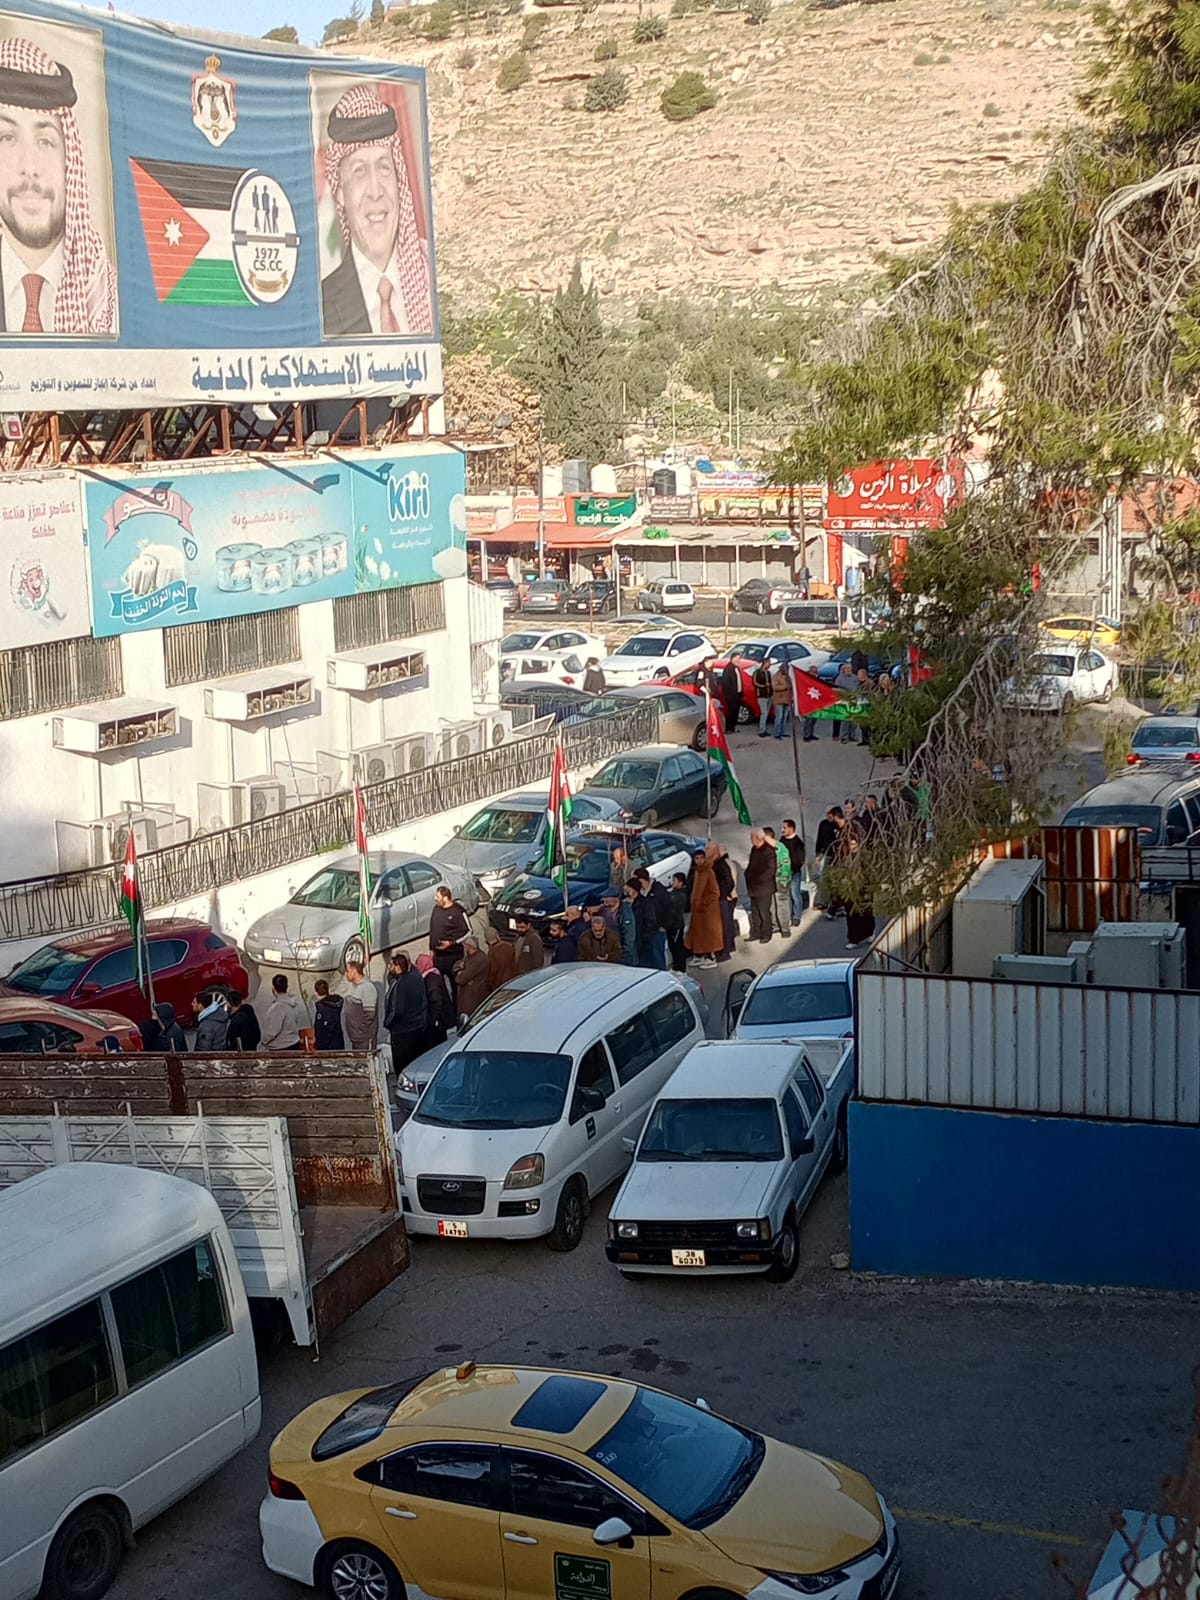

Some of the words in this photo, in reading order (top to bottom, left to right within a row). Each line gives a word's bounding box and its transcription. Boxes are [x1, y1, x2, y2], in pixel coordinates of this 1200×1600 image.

[255, 247, 280, 260] 1977
[253, 260, 283, 272] CS.CC
[191, 355, 253, 400] المدنية
[367, 350, 428, 389] المؤسسة
[30, 377, 56, 393] التوزيع
[128, 379, 138, 391] من
[387, 472, 430, 521] Kiri
[2, 505, 26, 521] مناعة
[27, 502, 46, 522] تعزز
[48, 500, 71, 519] عناصر
[31, 524, 56, 539] طفلك
[171, 585, 185, 604] لحم
[124, 599, 152, 622] الخفيف
[496, 904, 511, 913] 911
